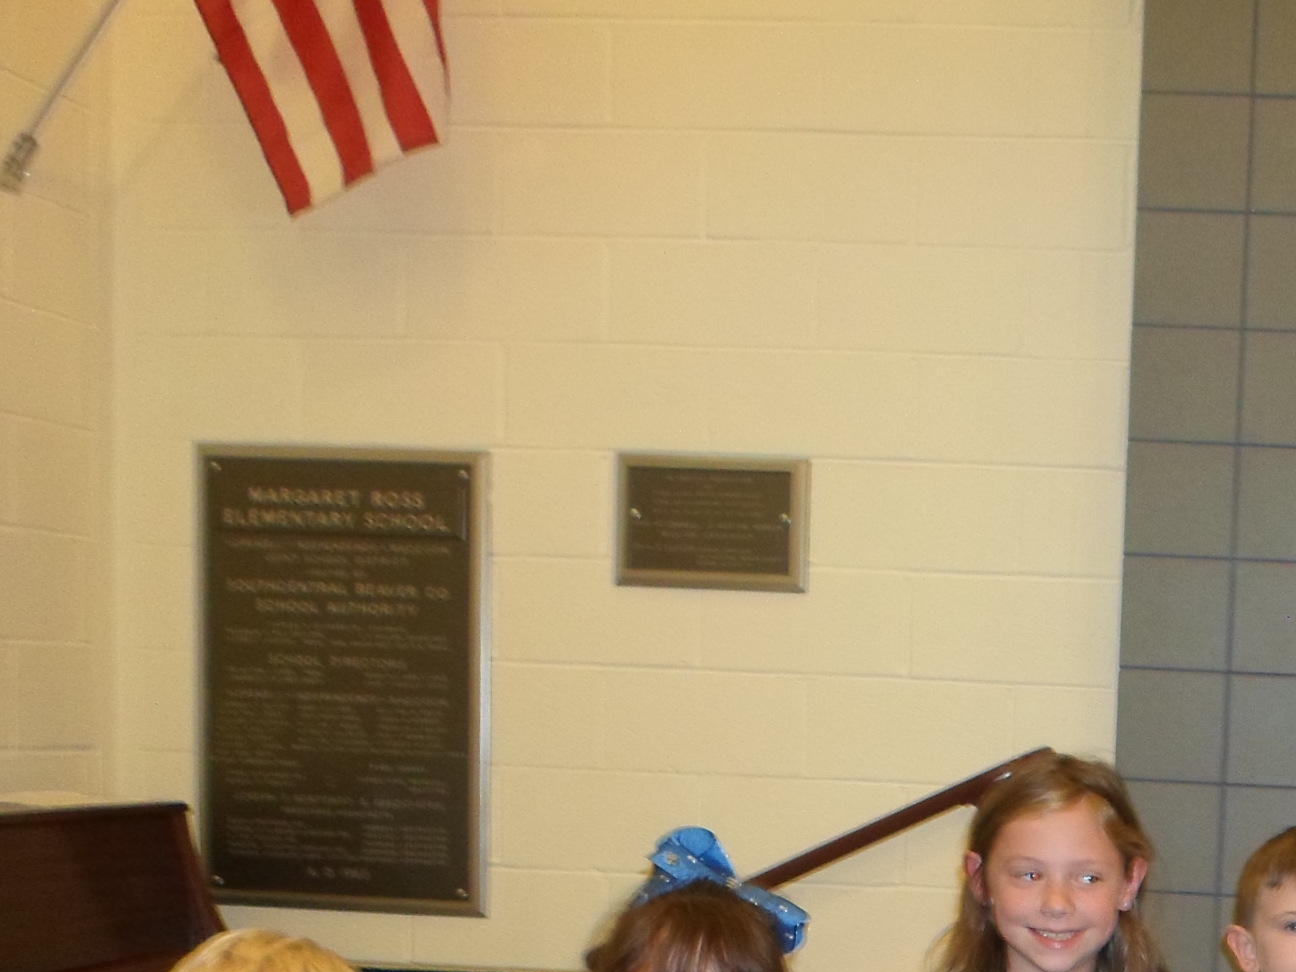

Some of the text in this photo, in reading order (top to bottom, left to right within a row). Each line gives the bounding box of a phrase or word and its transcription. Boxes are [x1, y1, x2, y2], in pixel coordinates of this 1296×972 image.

[248, 486, 426, 510] MARGARET ROSS
[222, 507, 450, 533] ELEMENTARY SCHOOL
[255, 597, 320, 614] SCHOOL
